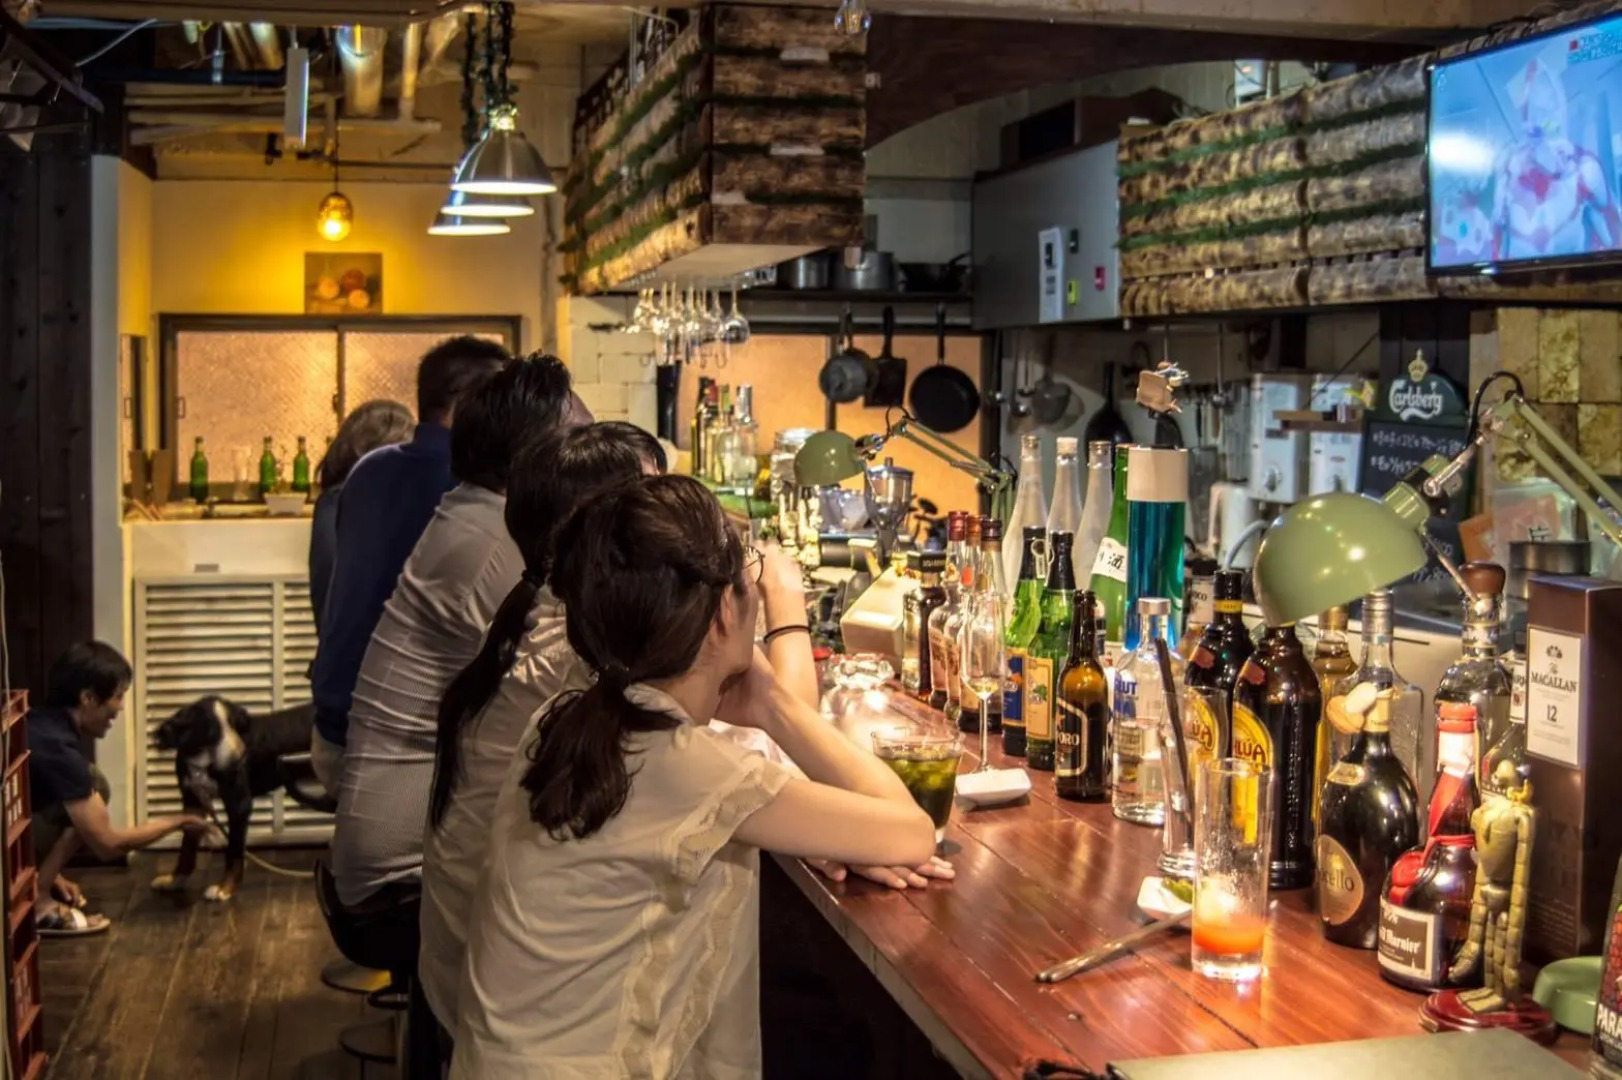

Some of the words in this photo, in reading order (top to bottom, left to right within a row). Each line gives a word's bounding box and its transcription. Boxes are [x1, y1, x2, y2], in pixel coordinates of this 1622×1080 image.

[1389, 379, 1443, 420] Carlsberg
[1530, 671, 1579, 693] MACALLAN
[1547, 704, 1558, 722] 12
